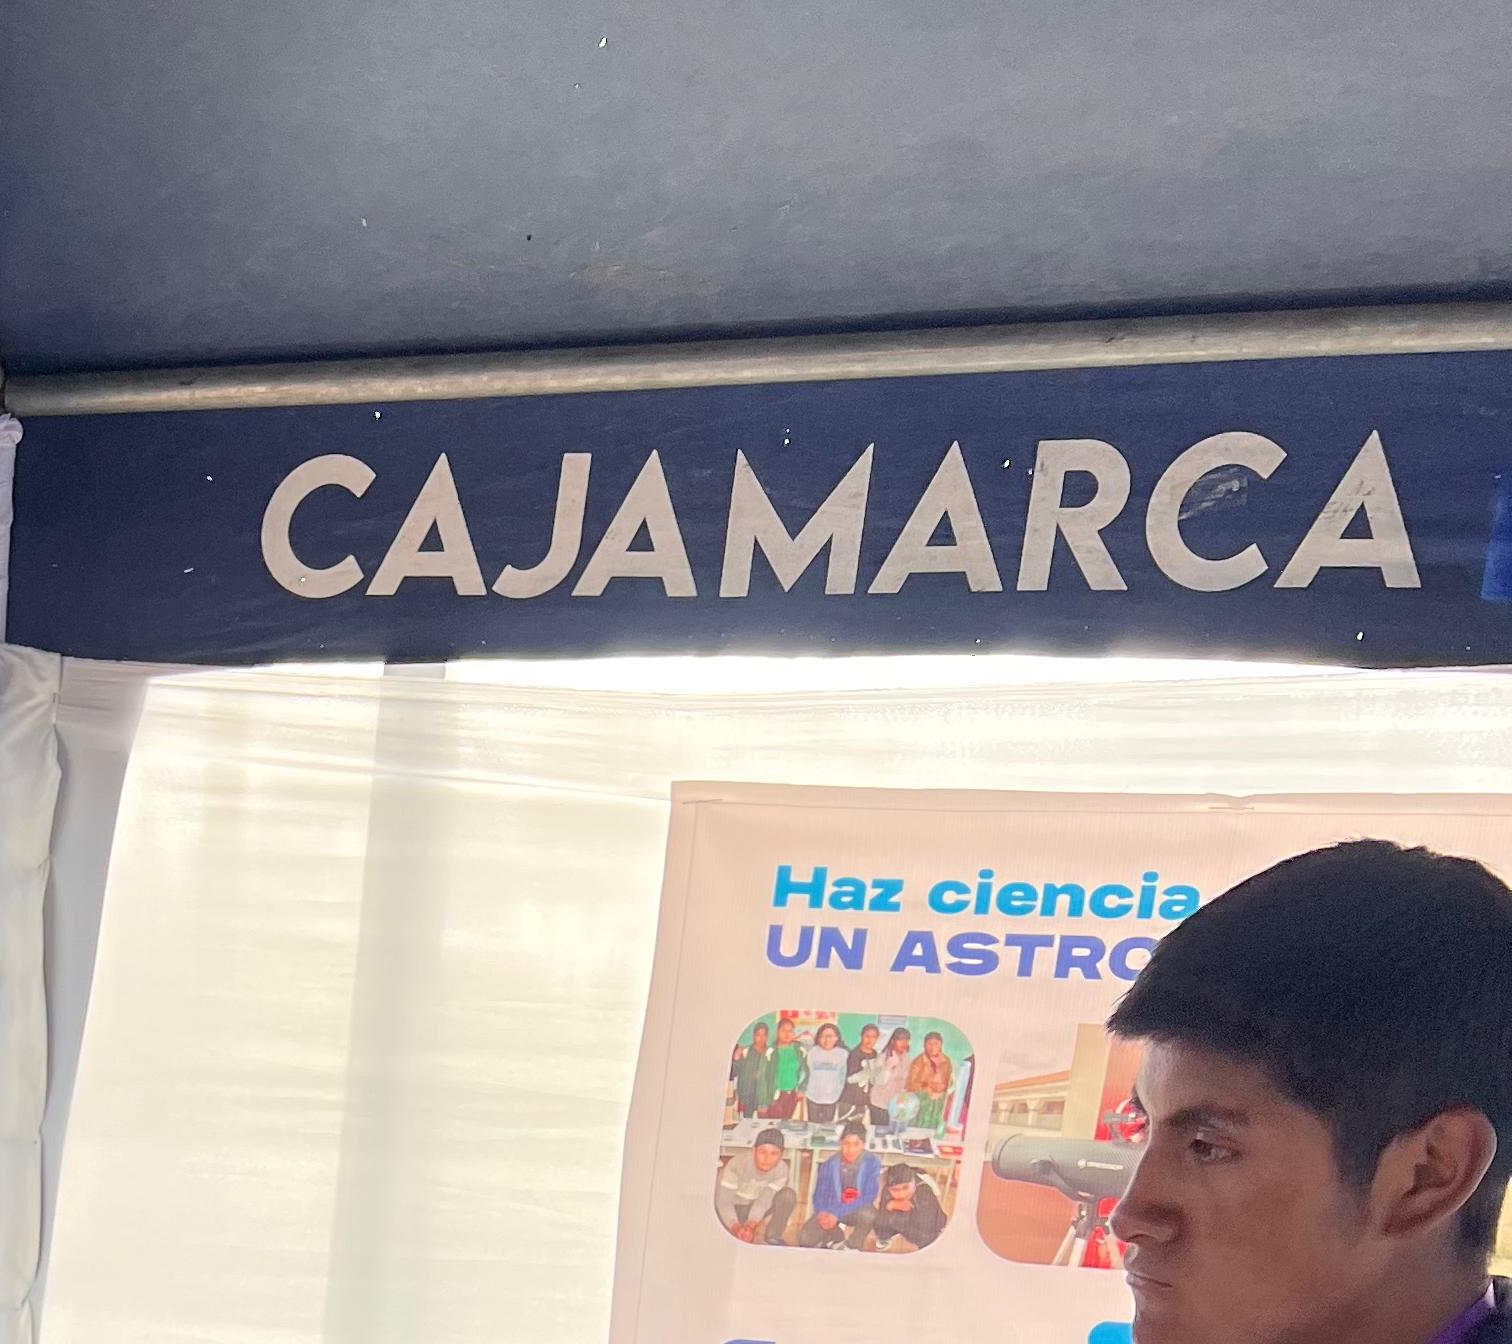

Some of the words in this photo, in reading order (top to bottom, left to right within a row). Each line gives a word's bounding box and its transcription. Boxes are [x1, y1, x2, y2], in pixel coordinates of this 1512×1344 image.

[260, 429, 1422, 599] CAJAMARCA
[772, 865, 904, 912] Haz
[928, 868, 1201, 920] ciencia
[765, 924, 870, 970] UN
